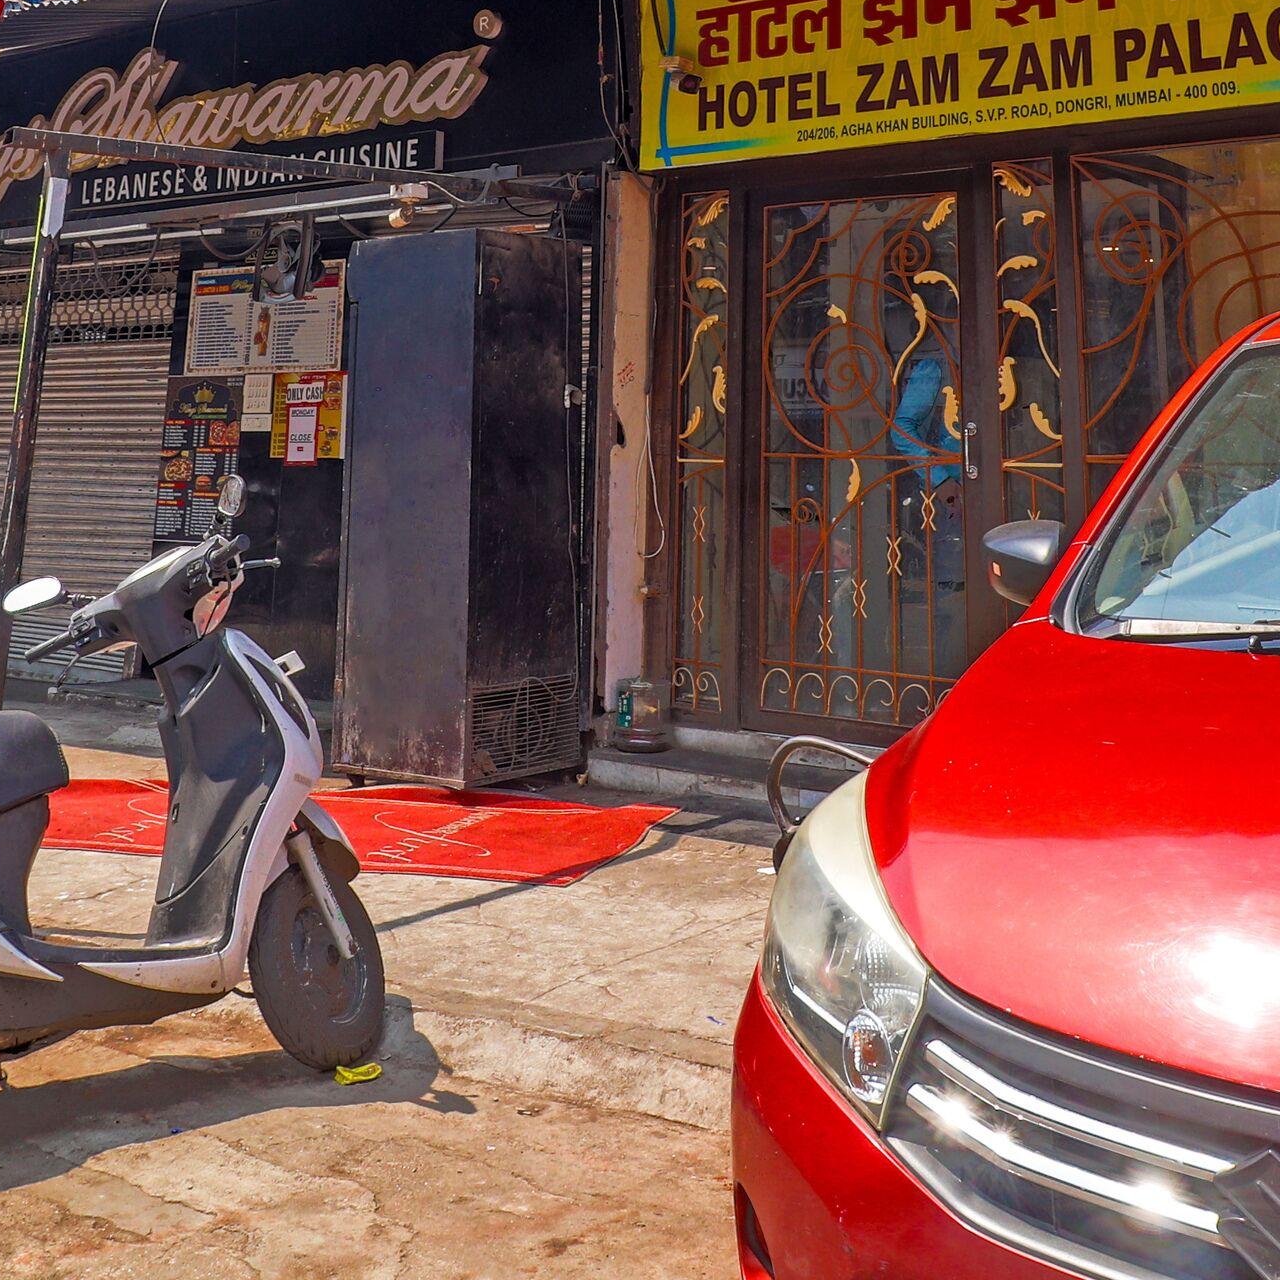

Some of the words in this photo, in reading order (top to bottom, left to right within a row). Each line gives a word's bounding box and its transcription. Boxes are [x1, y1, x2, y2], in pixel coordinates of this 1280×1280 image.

[698, 70, 840, 131] HOTEL
[856, 52, 959, 113] ZAM
[978, 34, 1092, 99] ZAM
[51, 45, 491, 172] Shawarma
[797, 126, 839, 142] 204/206,
[841, 120, 873, 137] AGHA
[876, 116, 909, 133] KHAN
[912, 111, 972, 130] BUILDING,
[975, 107, 1007, 123] S.V.P.
[1011, 103, 1052, 119] ROAD,
[1056, 95, 1111, 114] DONGRI,
[1115, 88, 1171, 107] MUMBAI
[1184, 84, 1207, 100] 400
[1211, 80, 1241, 96] 009.
[81, 169, 185, 205] LEBANESE
[192, 165, 208, 192] &
[287, 388, 304, 401] ONLY
[290, 433, 312, 441] CLOSE
